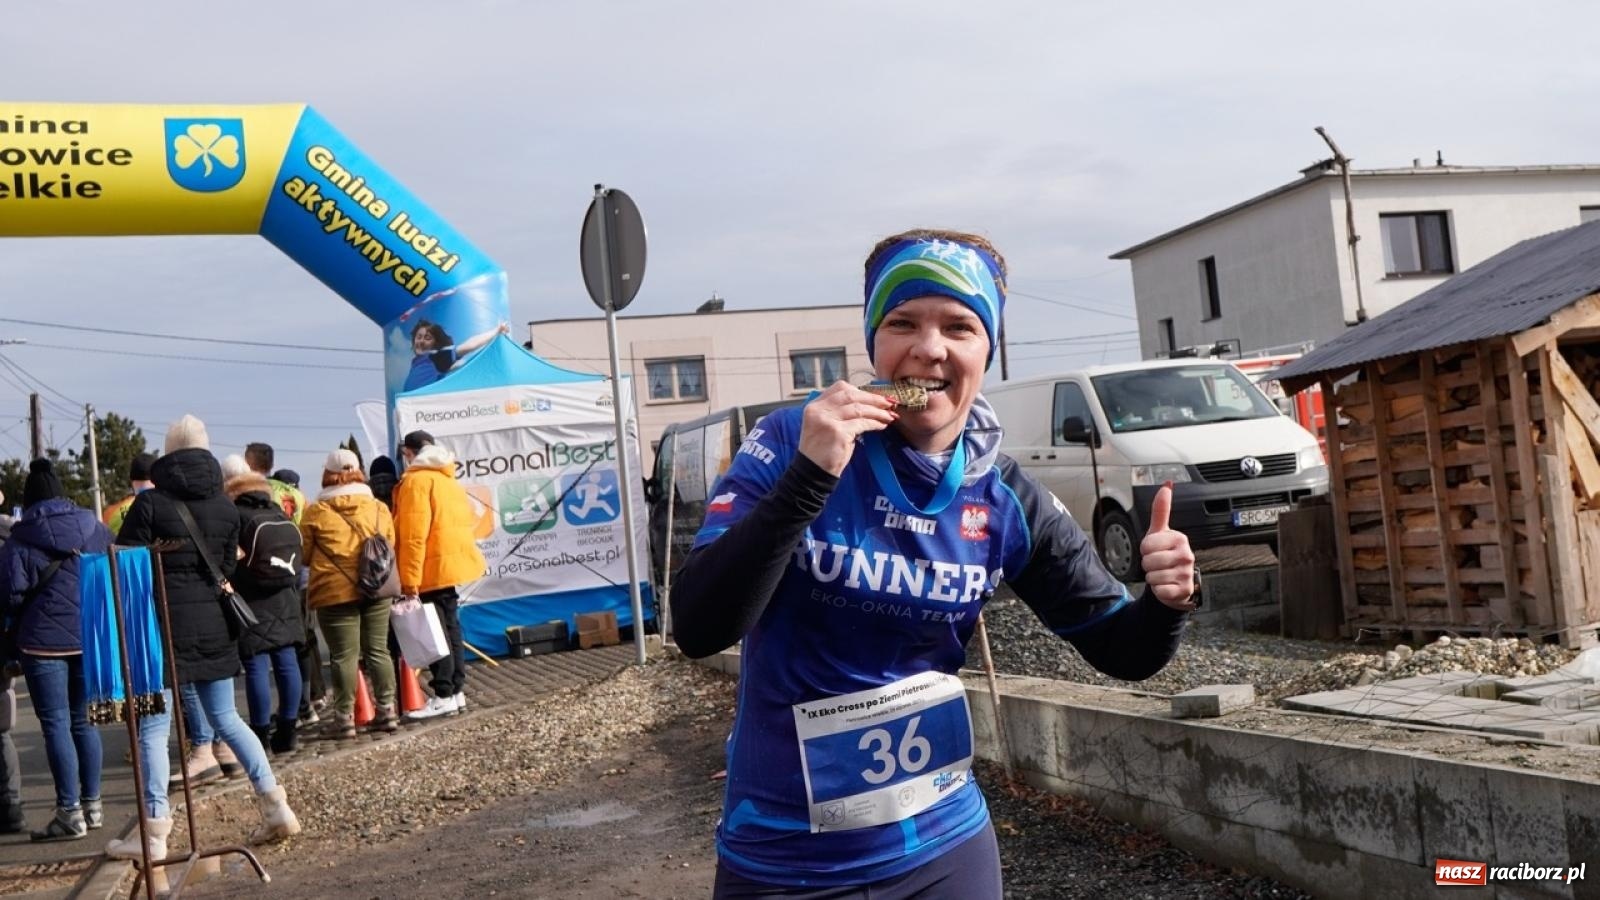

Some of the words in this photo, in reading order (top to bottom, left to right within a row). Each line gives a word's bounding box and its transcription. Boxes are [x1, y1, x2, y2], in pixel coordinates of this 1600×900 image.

[0, 115, 88, 134] ina
[307, 145, 390, 219] Gmina
[388, 211, 460, 273] ludzi
[283, 176, 428, 297] aktywnych
[454, 440, 616, 479] ersonalBest
[920, 609, 965, 625] TEAM
[808, 710, 818, 720] IX
[820, 708, 836, 717] Eko
[837, 702, 865, 713] Cross
[866, 700, 878, 710] po
[858, 716, 931, 785] 36
